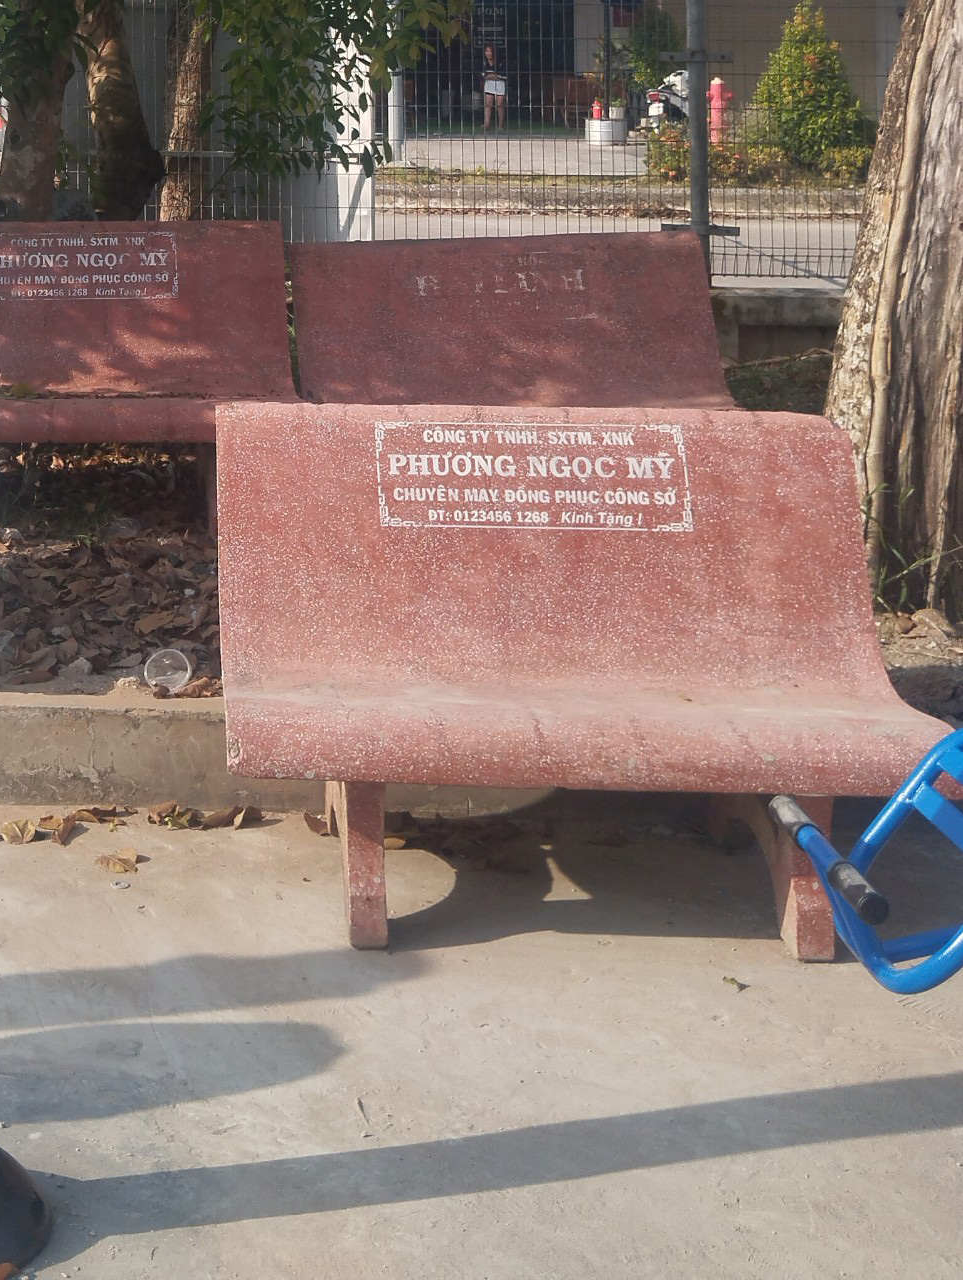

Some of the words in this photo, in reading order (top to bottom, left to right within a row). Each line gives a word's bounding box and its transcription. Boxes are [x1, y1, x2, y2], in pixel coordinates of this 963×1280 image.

[11, 237, 38, 247] CÔNG
[41, 238, 53, 247] TY
[76, 252, 131, 270] NGỌC
[139, 249, 168, 266] MỸ
[35, 275, 56, 284] MAY
[123, 271, 152, 283] CÔNG
[67, 288, 88, 296] 1268
[423, 427, 466, 444] CÔNG
[471, 429, 489, 443] TY
[602, 431, 635, 446] XNK
[387, 451, 516, 477] PHƯƠNG
[526, 455, 616, 483] NGỌC
[627, 451, 675, 479] MỸ
[393, 484, 460, 502] CHUYÊN
[464, 488, 498, 503] MAY
[504, 484, 550, 504] ĐỒNG
[604, 488, 650, 505] CÔNG
[654, 488, 677, 505] SỞ
[453, 510, 512, 522] 0123456
[516, 511, 549, 523] 1268
[560, 511, 594, 524] Kính
[597, 512, 633, 526] Tặng
